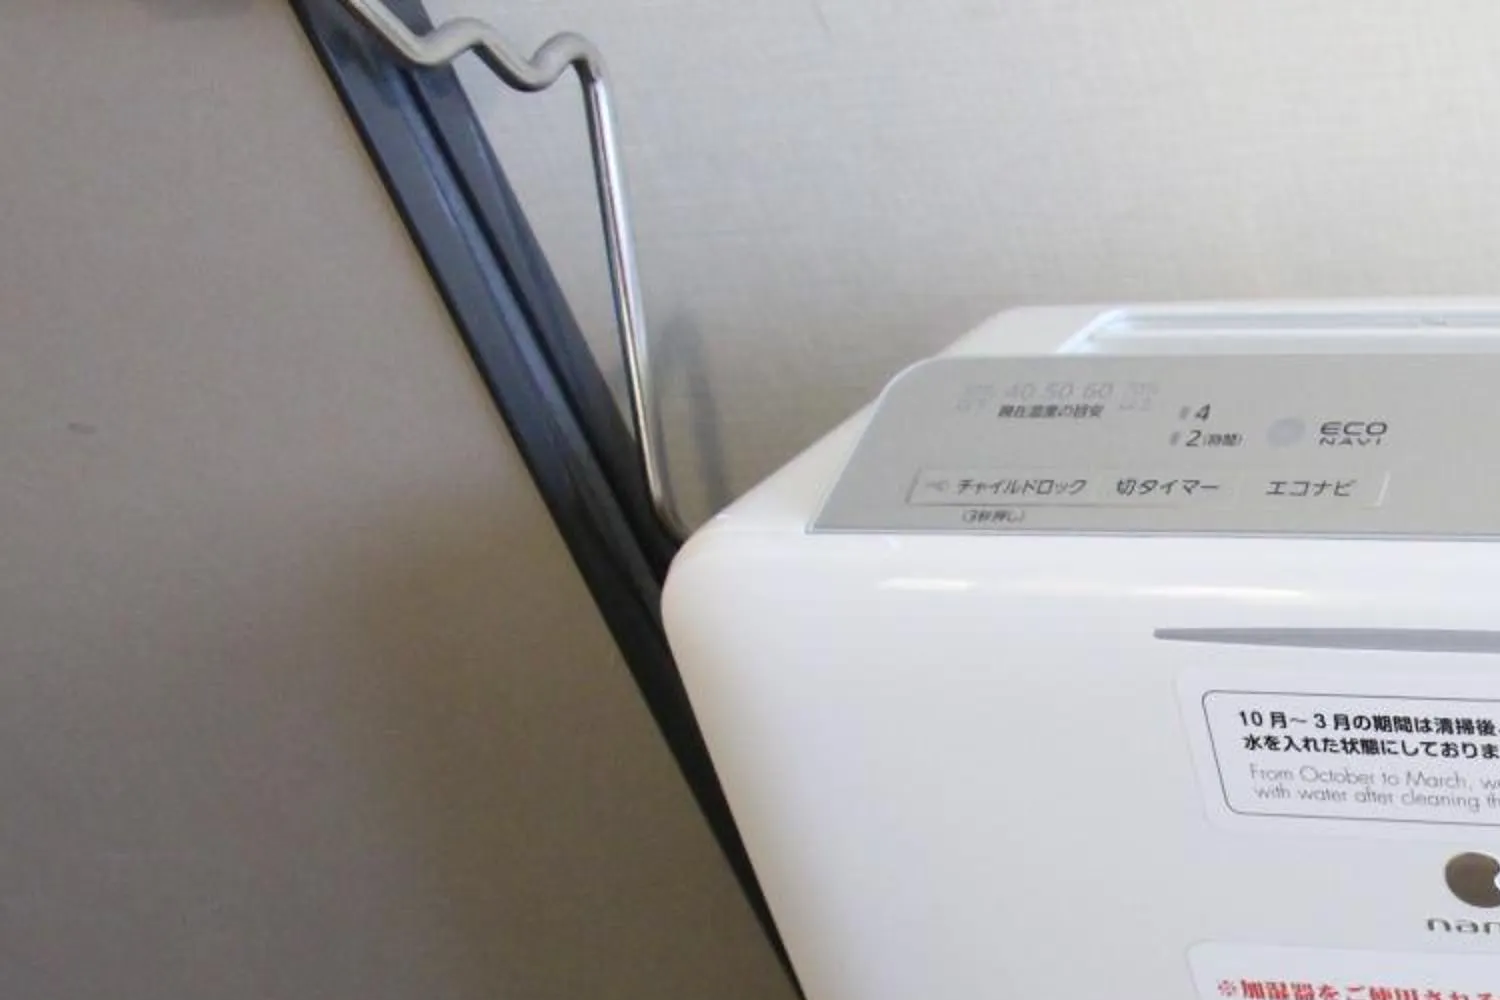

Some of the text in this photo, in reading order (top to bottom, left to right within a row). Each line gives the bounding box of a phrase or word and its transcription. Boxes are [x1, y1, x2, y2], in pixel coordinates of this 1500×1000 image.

[1193, 403, 1211, 423] 4
[1320, 420, 1388, 437] ECO
[1319, 437, 1382, 446] NAVI
[956, 478, 1086, 495] チャイルドロック
[1116, 478, 1220, 496] 切タイマー
[1266, 480, 1357, 497] エコナビ
[1249, 764, 1294, 781] From
[1300, 768, 1374, 785] October
[1382, 769, 1399, 786] to
[1254, 783, 1293, 800] with
[1297, 789, 1346, 802] water
[1354, 787, 1394, 804] after
[1400, 788, 1480, 813] cleaning
